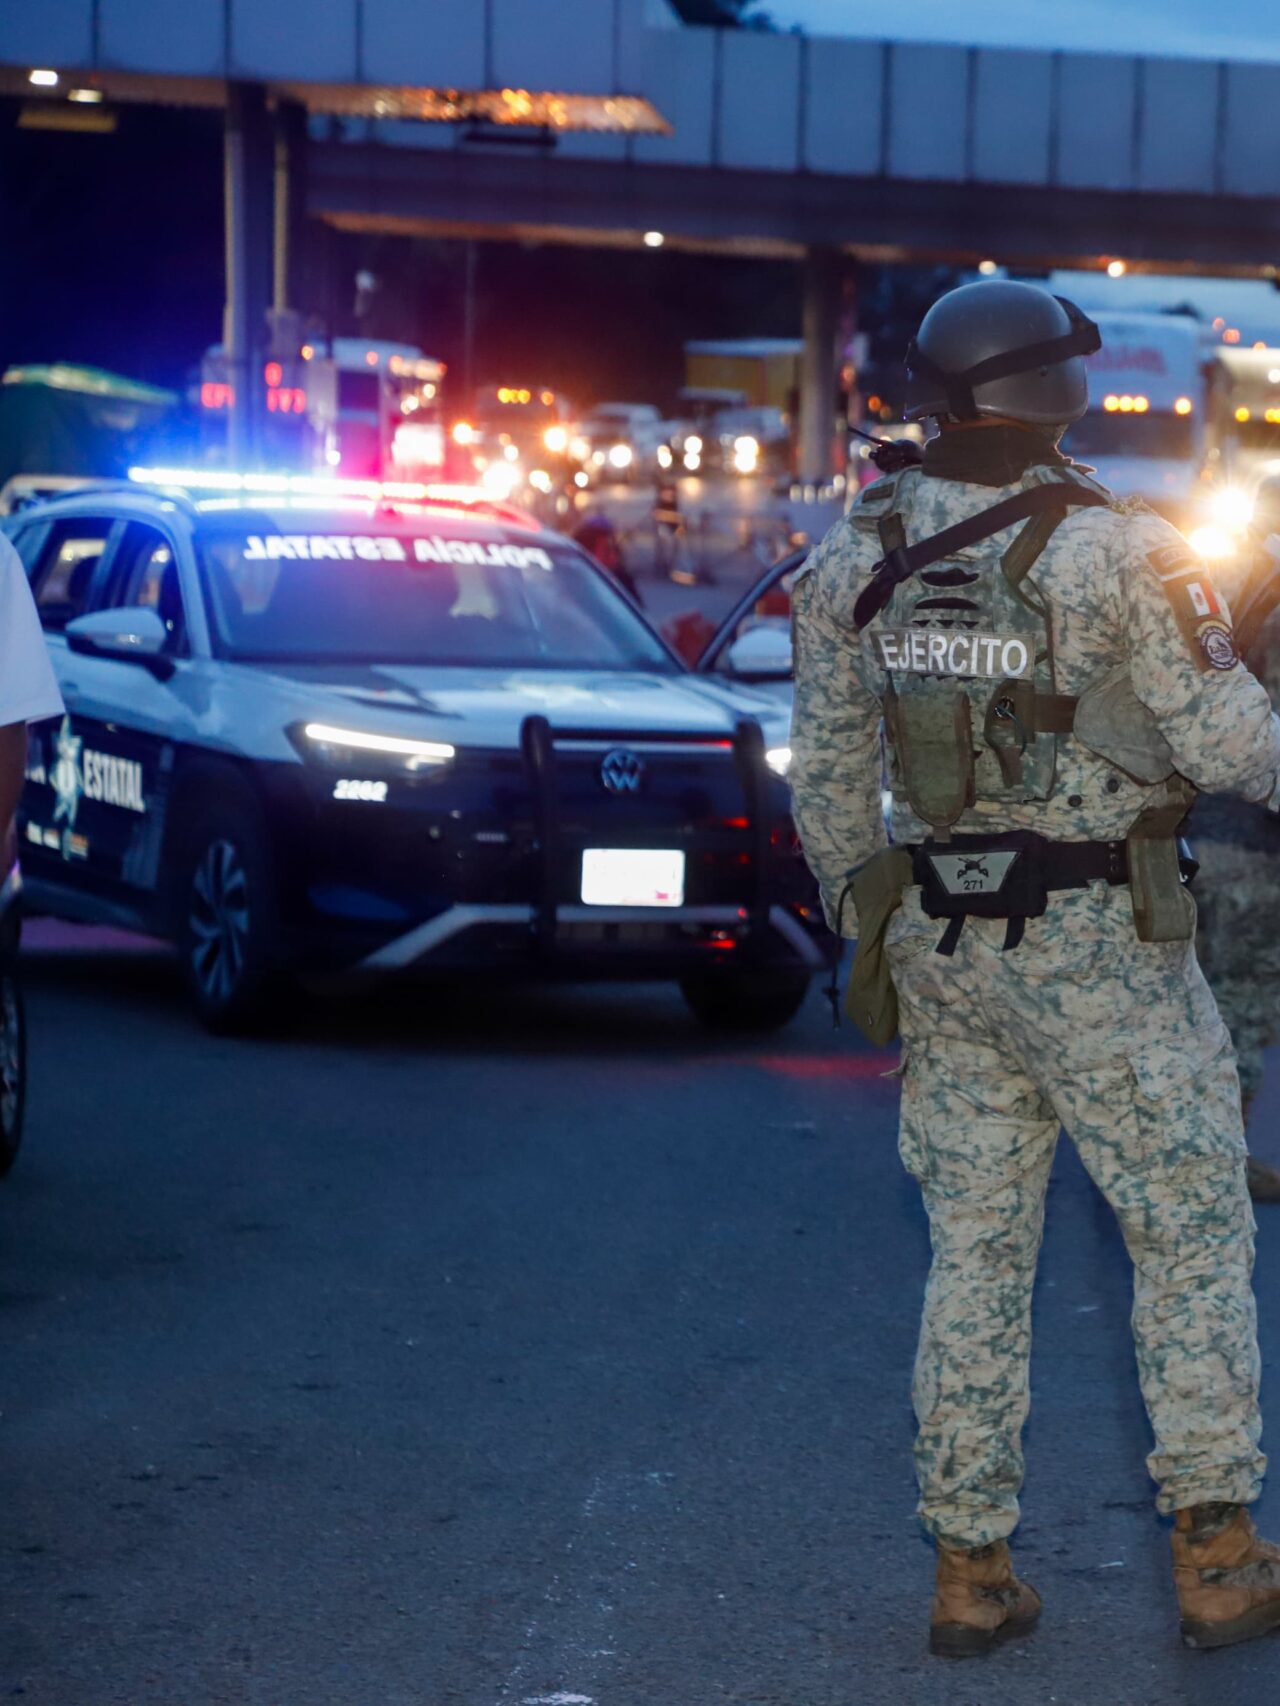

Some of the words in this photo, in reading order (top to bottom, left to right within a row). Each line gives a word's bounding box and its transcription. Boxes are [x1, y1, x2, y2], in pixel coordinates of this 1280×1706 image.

[878, 633, 1028, 677] EJERCITO
[83, 747, 145, 813] ESTATAL
[963, 880, 983, 891] 271
